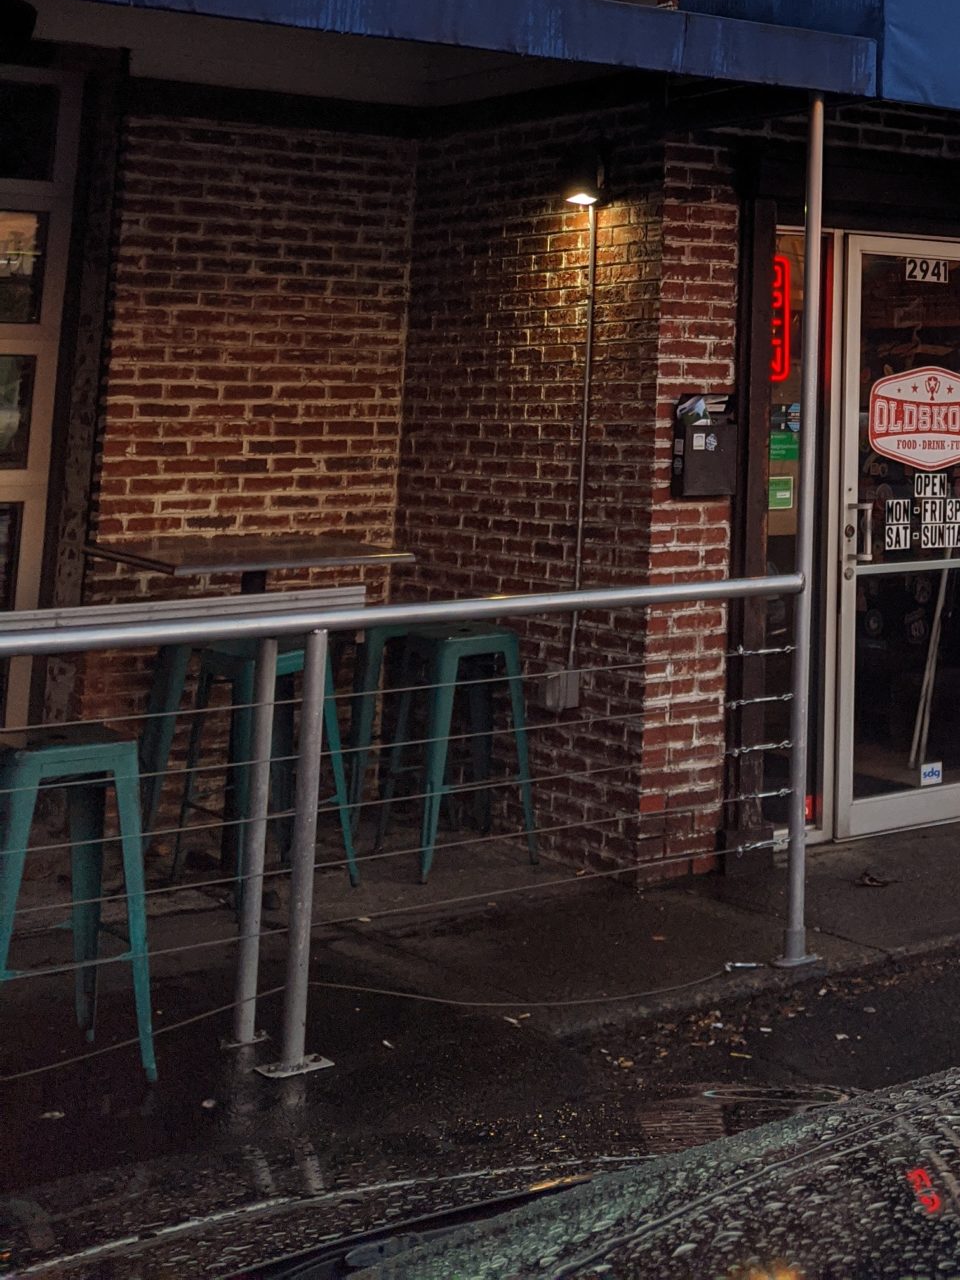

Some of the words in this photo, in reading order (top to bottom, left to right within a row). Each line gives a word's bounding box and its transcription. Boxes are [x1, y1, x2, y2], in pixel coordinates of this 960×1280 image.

[907, 259, 948, 282] 2941
[896, 439, 917, 450] FOOD
[922, 439, 946, 451] DRINK
[915, 474, 946, 496] OPEN
[886, 500, 910, 523] MON
[923, 500, 943, 522] FRI
[886, 526, 910, 548] SAT
[922, 524, 945, 547] SUN
